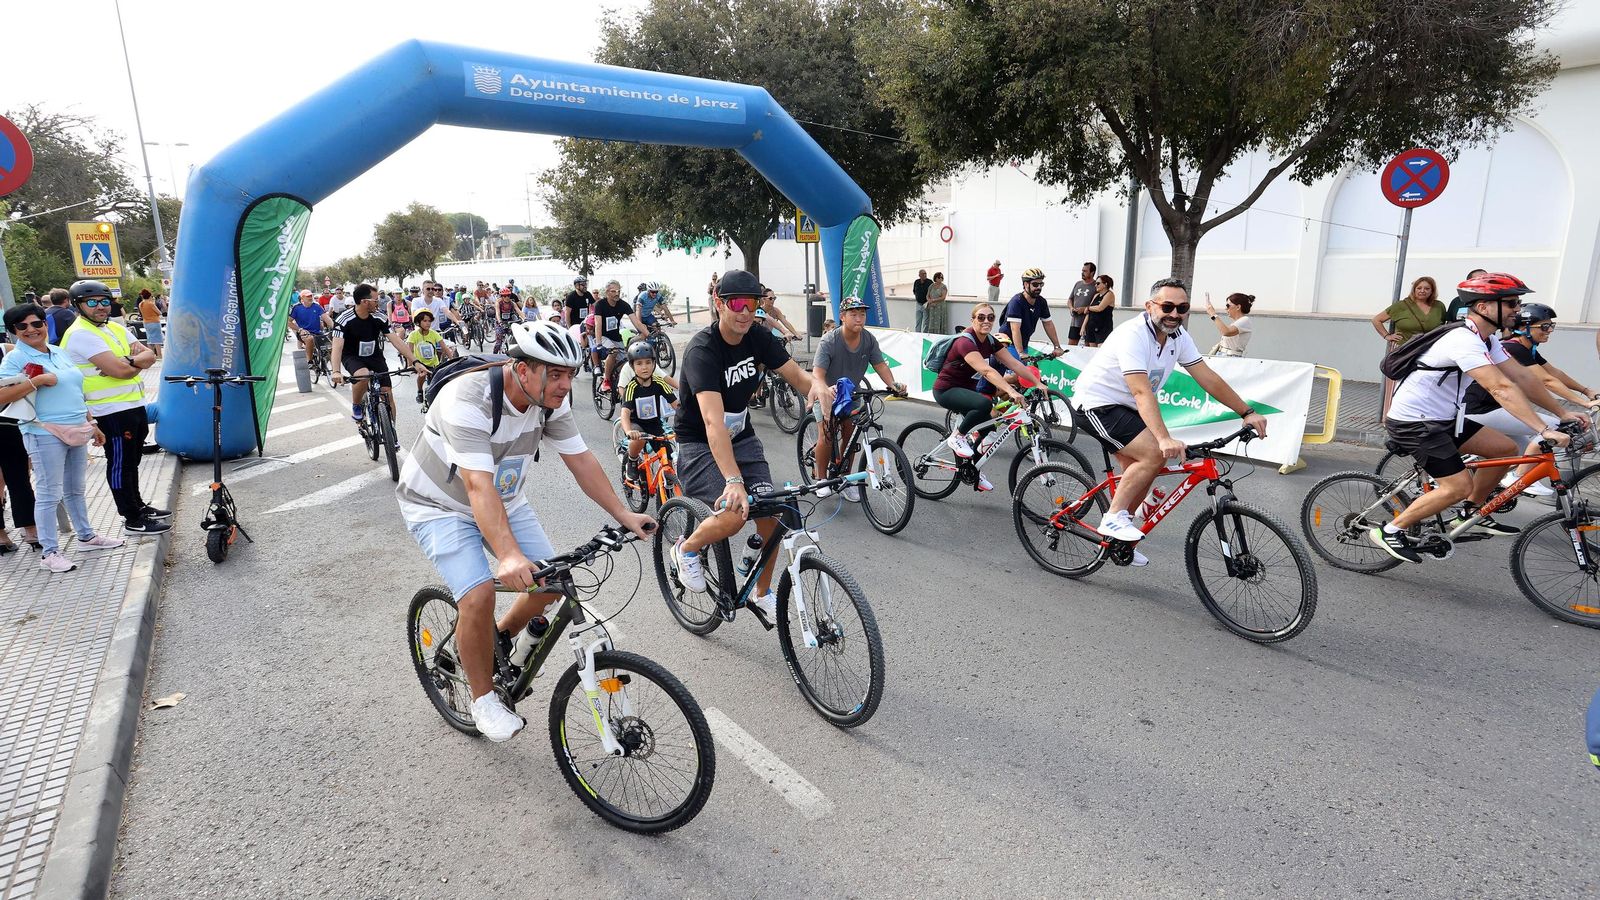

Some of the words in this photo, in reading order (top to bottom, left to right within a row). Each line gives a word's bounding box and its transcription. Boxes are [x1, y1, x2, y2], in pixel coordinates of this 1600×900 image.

[510, 73, 662, 102] Ayuntamiento
[669, 93, 689, 104] de
[694, 95, 739, 110] Jerez
[510, 87, 586, 105] Deportes
[82, 267, 117, 276] PEATONES
[260, 276, 284, 320] Corte
[724, 356, 757, 388] VANS
[1040, 371, 1059, 385] orte
[1058, 369, 1077, 392] Ing
[1156, 389, 1170, 405] El
[1170, 391, 1202, 410] Corte
[1147, 478, 1195, 524] TREK
[1479, 479, 1526, 517] TREK
